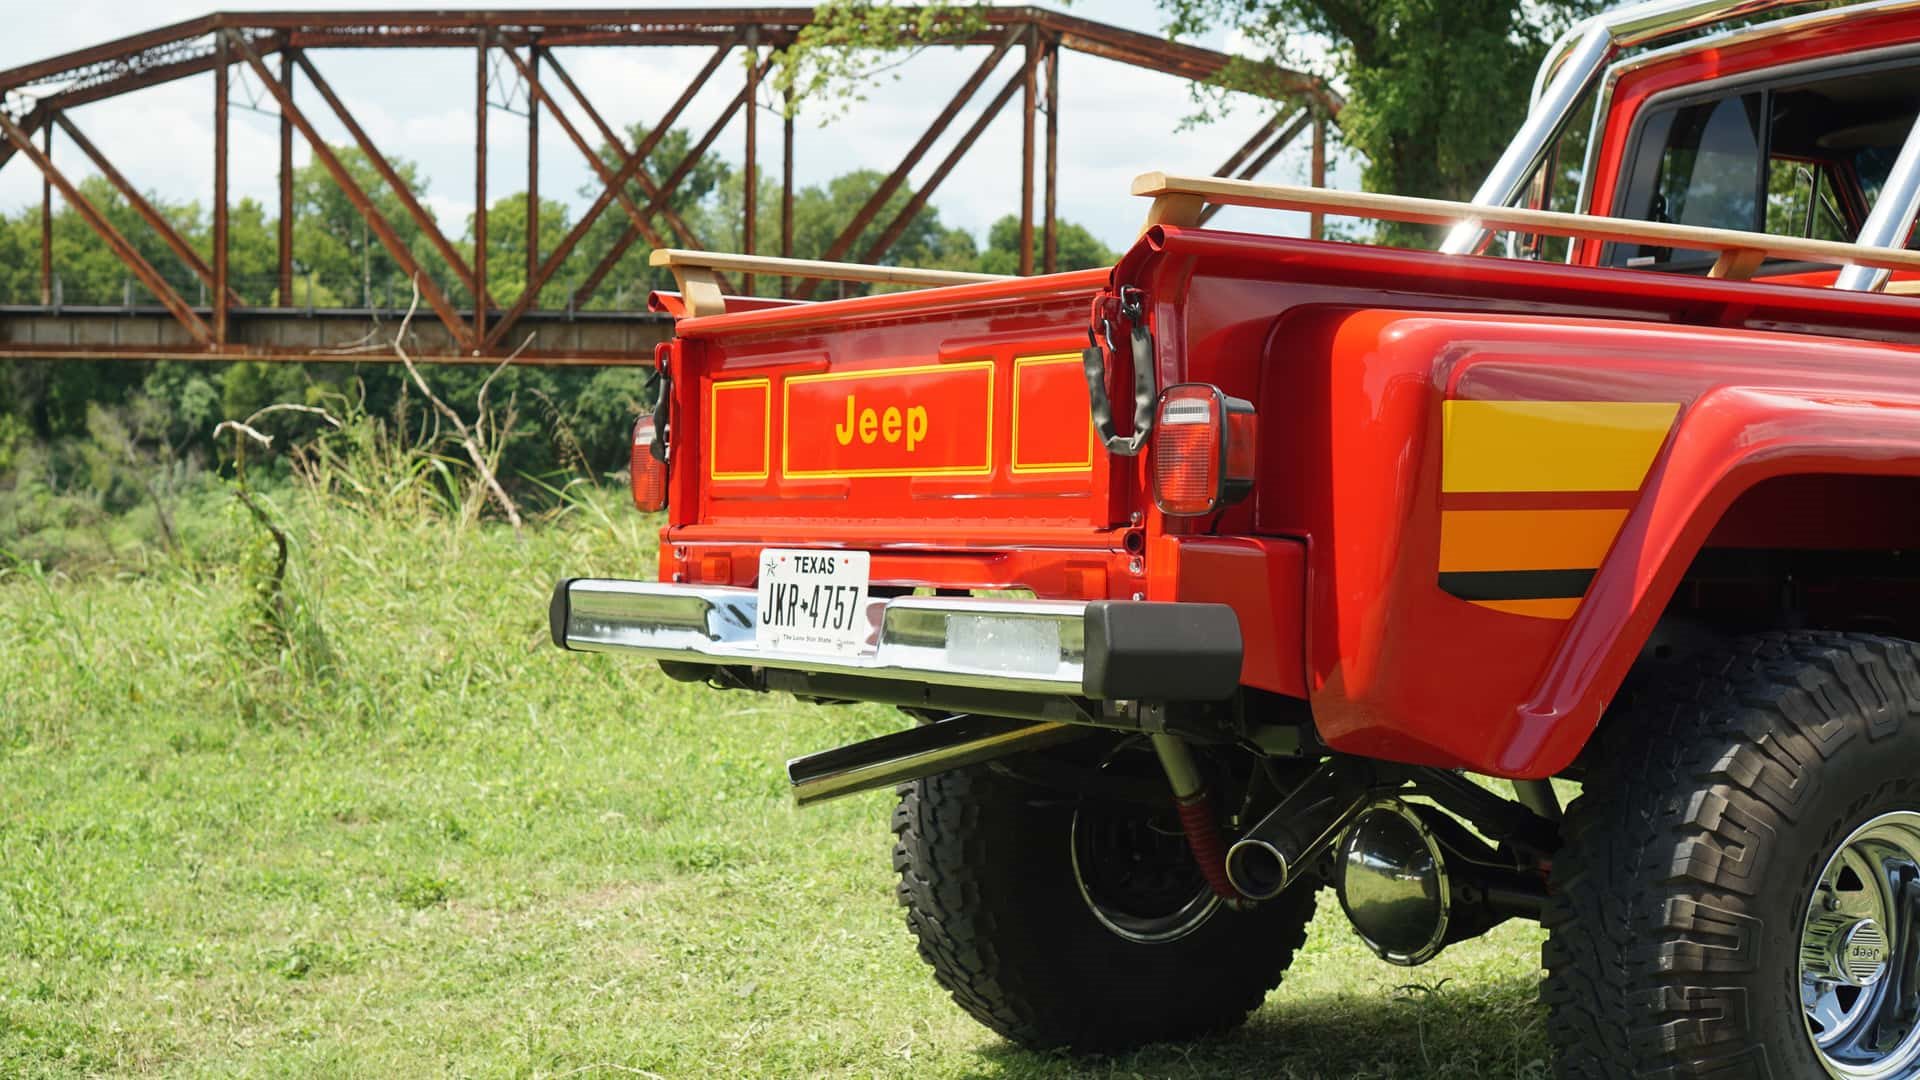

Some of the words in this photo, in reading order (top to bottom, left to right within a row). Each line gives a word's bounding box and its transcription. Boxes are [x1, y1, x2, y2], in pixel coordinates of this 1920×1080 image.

[835, 394, 928, 452] Jeep
[794, 556, 835, 574] TEXAS
[1852, 945, 1880, 960] Jeep
